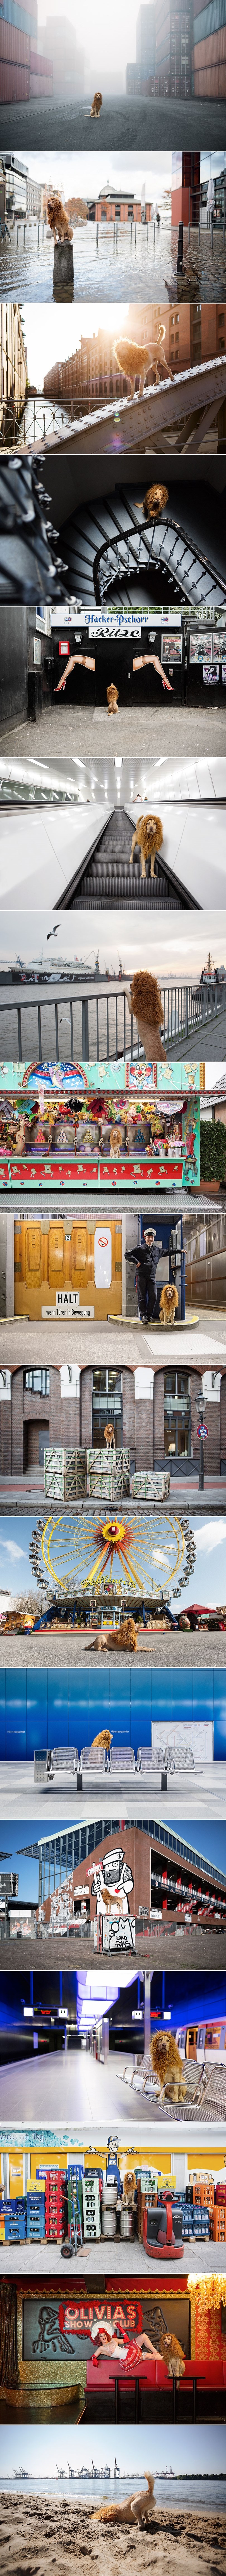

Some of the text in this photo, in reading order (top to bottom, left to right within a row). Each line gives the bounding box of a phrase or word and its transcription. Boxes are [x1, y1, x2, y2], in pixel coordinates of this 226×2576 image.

[84, 614, 149, 626] Hacker-Pschorr
[91, 628, 140, 637] Ritze
[58, 1294, 78, 1303] HALT
[81, 1575, 136, 1588] Willenborg
[32, 2133, 44, 2142] 1kg
[65, 2305, 136, 2320] OLIVIAS
